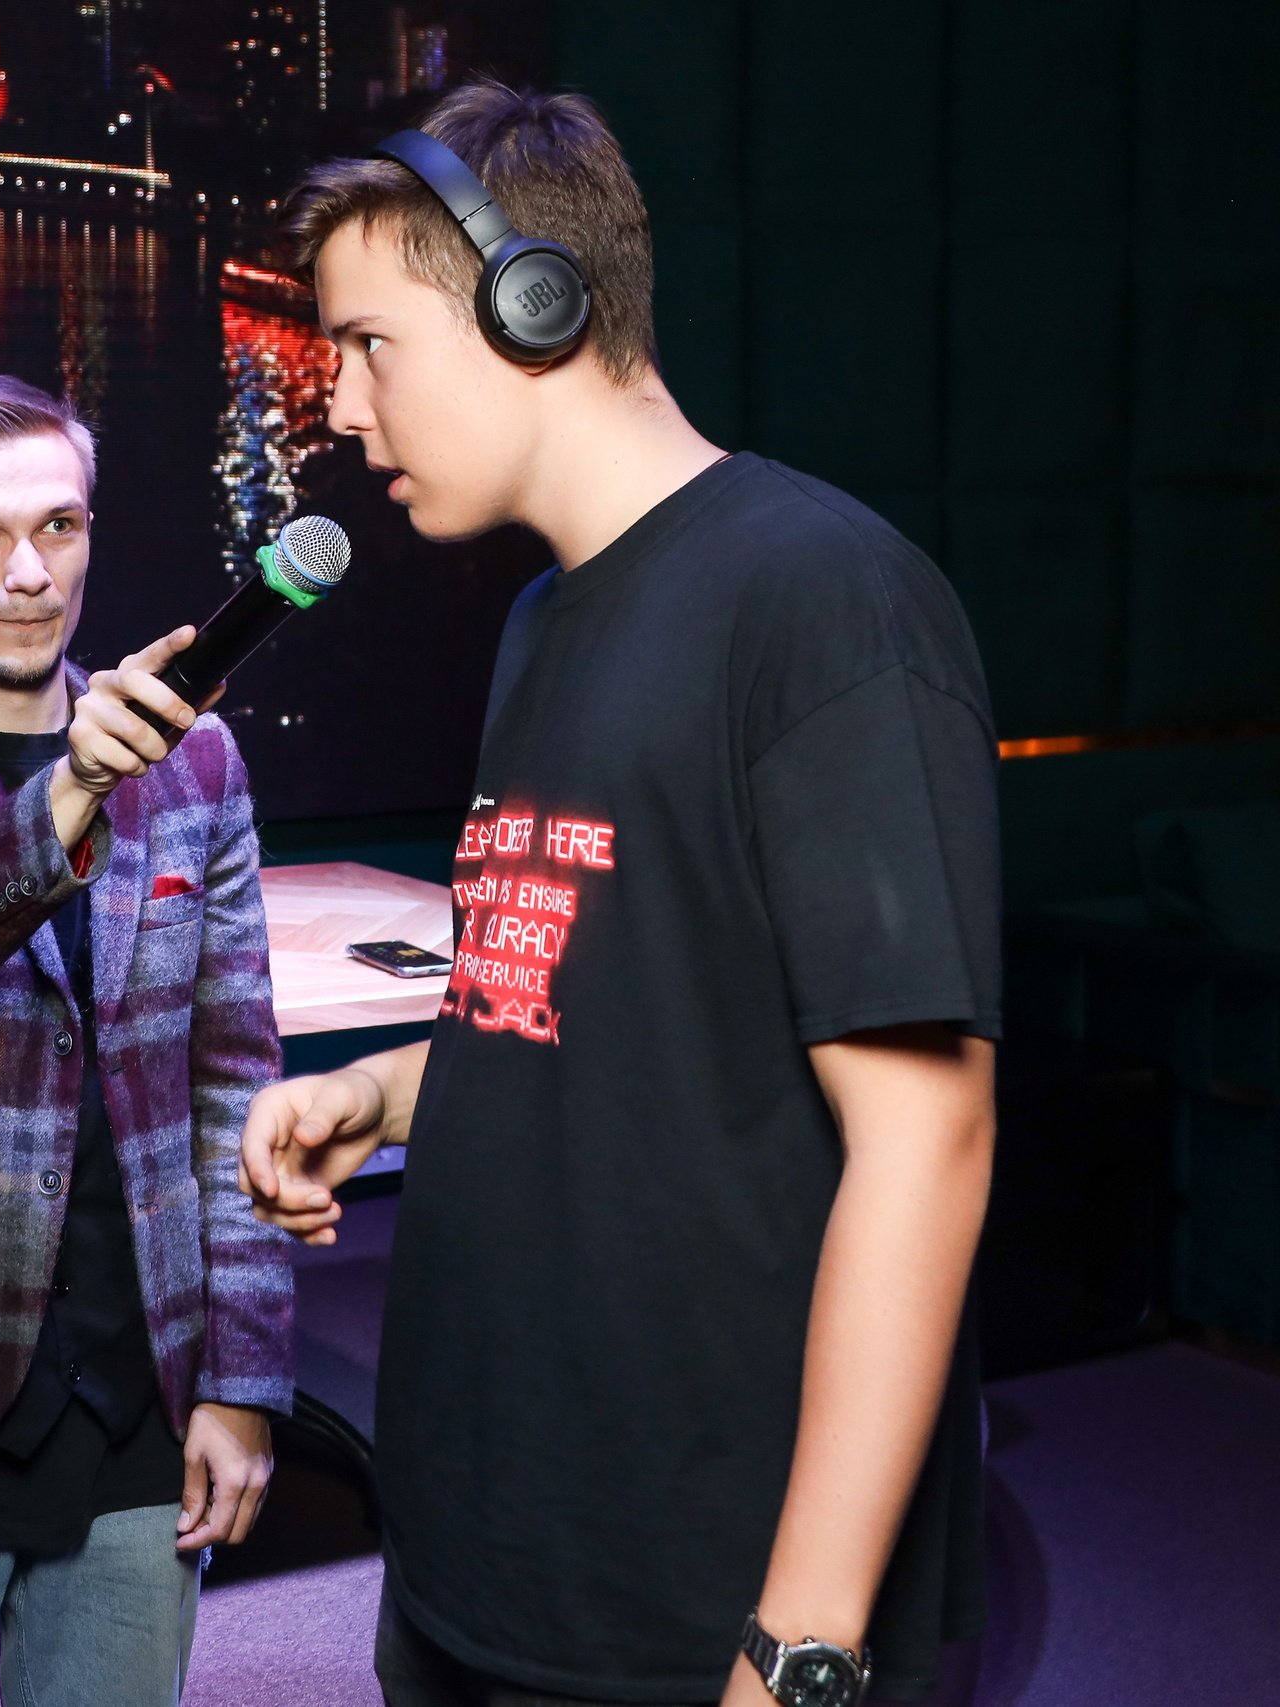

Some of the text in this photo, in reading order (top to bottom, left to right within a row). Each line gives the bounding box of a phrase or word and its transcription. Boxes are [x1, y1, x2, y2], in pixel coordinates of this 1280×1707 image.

[524, 276, 568, 318] JBL
[546, 819, 614, 866] HERE
[517, 882, 575, 917] ENSURE
